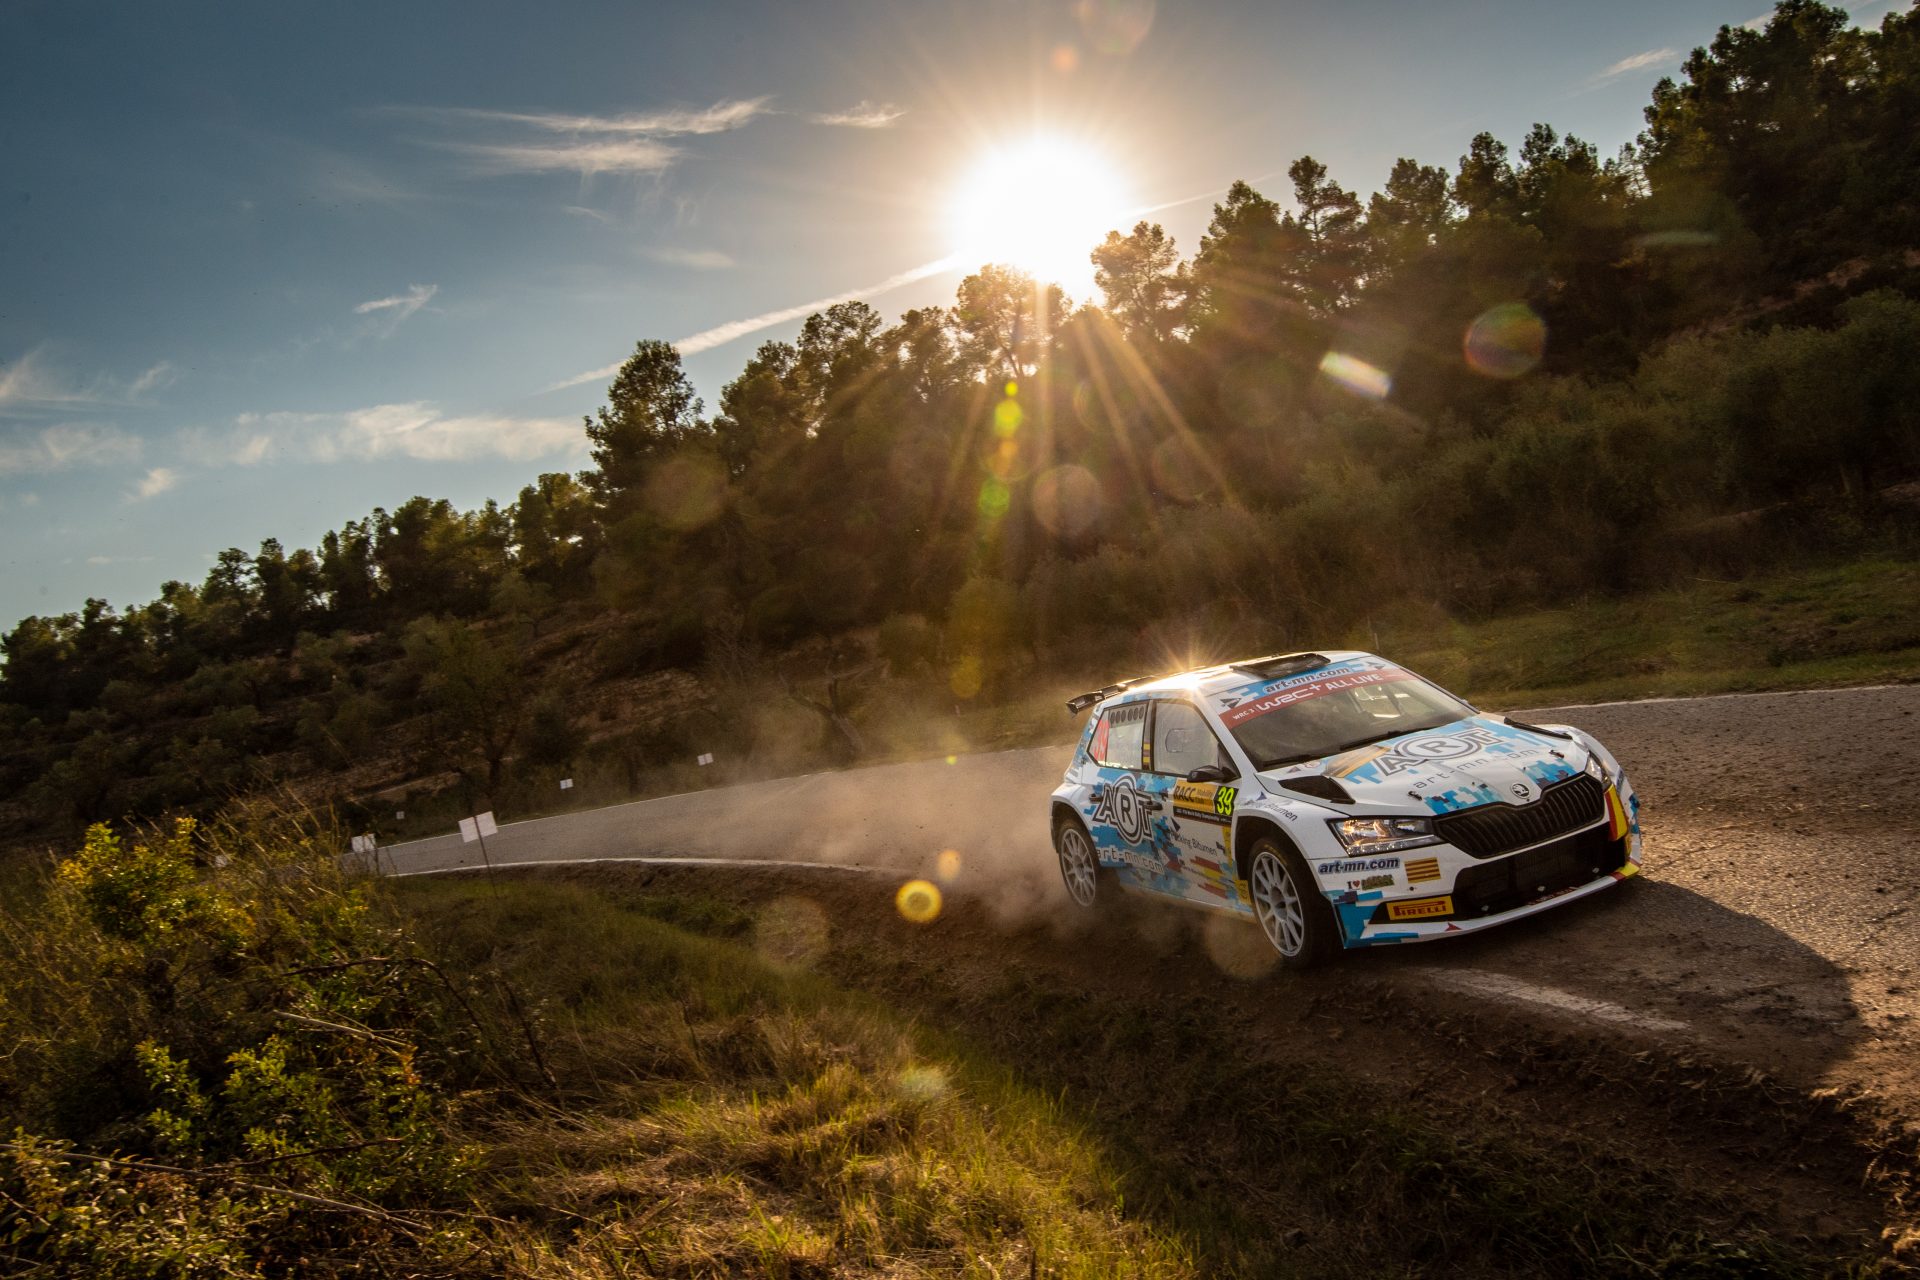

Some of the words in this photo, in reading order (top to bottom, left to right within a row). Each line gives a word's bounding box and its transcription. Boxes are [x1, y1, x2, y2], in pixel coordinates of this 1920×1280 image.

[1264, 666, 1350, 695] art-mn.com
[1326, 680, 1351, 692] ALL
[1351, 673, 1384, 686] LIVE
[1374, 727, 1505, 777] ART
[1173, 785, 1197, 803] RACC
[1216, 786, 1235, 816] 39
[1092, 776, 1153, 845] ART
[1319, 858, 1400, 874] art-mn.com
[1393, 901, 1447, 917] PIRELLI
